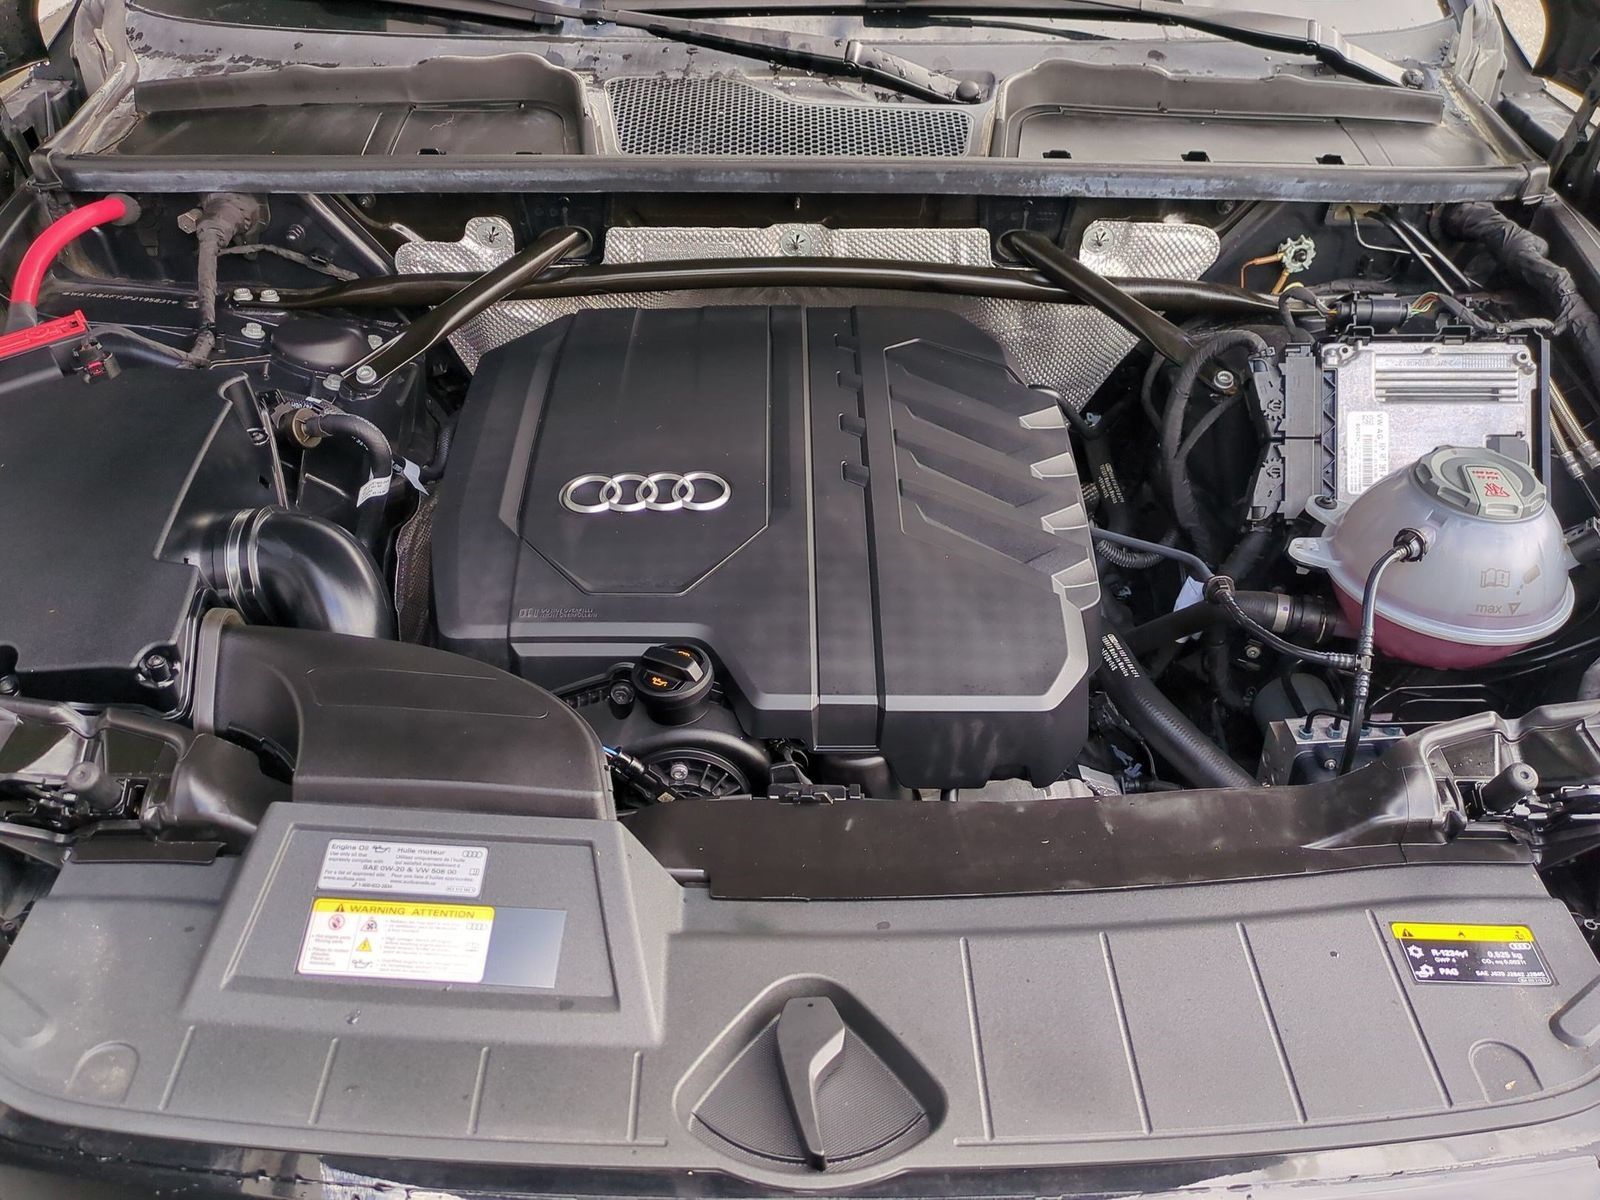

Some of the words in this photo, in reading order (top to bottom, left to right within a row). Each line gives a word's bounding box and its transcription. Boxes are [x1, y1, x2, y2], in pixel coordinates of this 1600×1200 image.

[1476, 604, 1502, 614] max
[350, 904, 406, 915] WARNING
[411, 907, 475, 918] ATTENTION
[1511, 951, 1523, 960] kg
[1439, 967, 1460, 976] PAG
